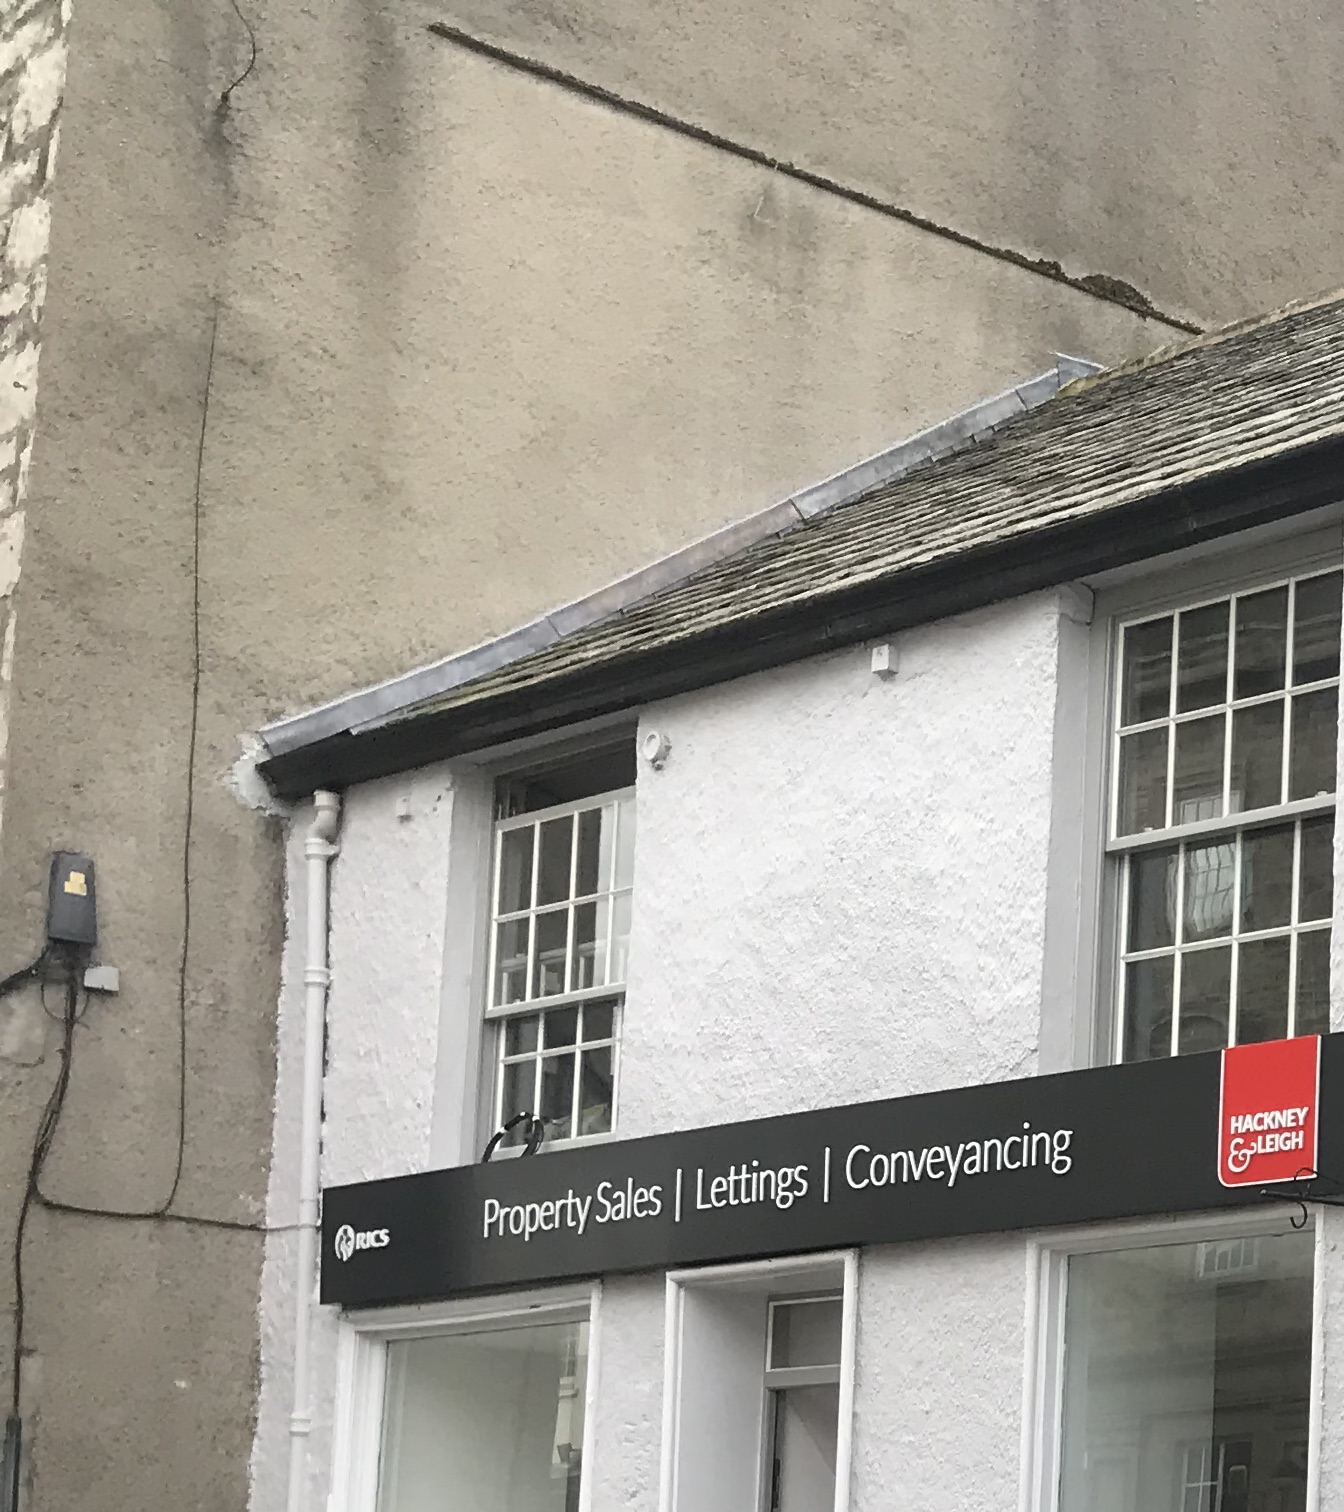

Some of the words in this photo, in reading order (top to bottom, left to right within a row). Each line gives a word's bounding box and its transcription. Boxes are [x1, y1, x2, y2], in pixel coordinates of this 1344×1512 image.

[1230, 1106, 1309, 1135] HACKNEY
[355, 1228, 391, 1250] RICS
[483, 1187, 593, 1242] Property
[595, 1176, 663, 1223] Sales
[696, 1159, 809, 1210] Lettings
[845, 1121, 1074, 1189] Conveyancing
